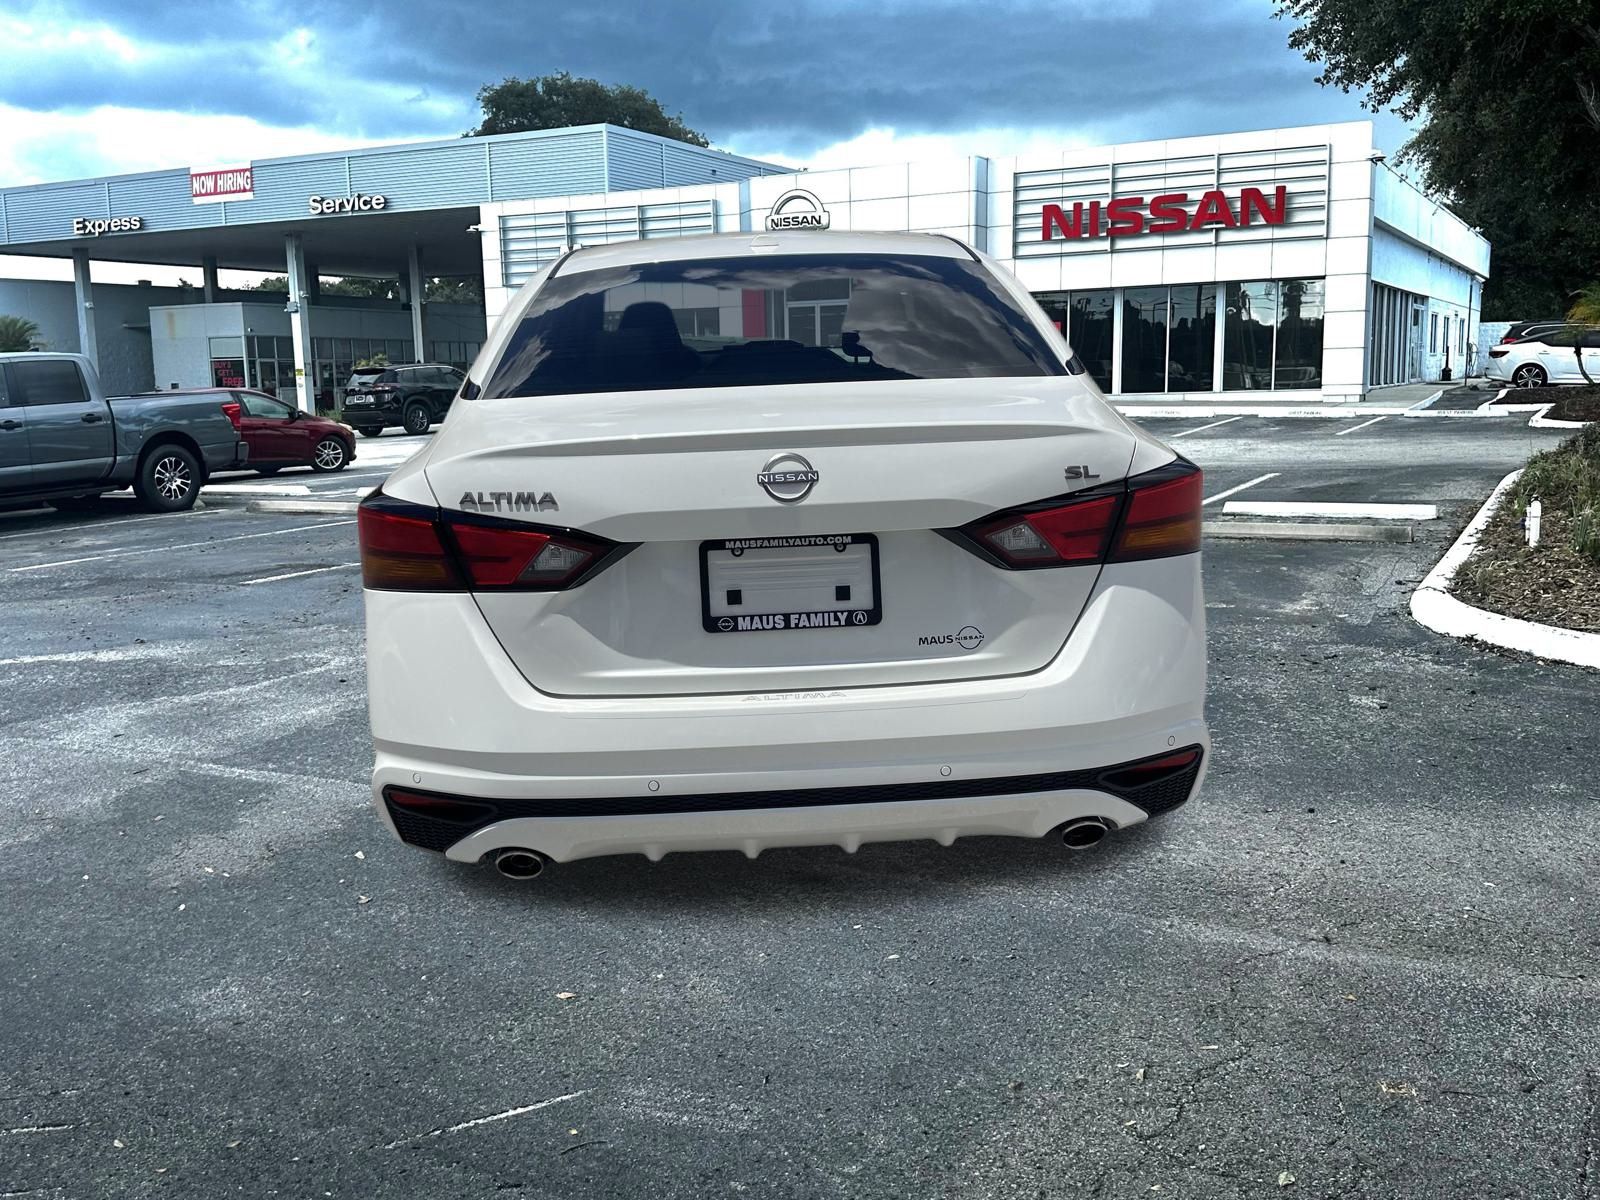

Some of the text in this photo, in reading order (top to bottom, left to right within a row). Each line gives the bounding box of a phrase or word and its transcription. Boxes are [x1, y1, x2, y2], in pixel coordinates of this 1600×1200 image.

[192, 171, 251, 195] NOW HIRING
[308, 193, 385, 215] Service
[1041, 185, 1287, 241] NISSAN
[72, 216, 141, 237] Express
[770, 215, 822, 228] NISSAN
[223, 377, 244, 386] FREE
[758, 472, 818, 483] NISSAN
[1064, 465, 1100, 479] SL
[459, 491, 558, 508] ALTIMA
[725, 535, 852, 550] MAUSFAMILYAUTO.COM
[737, 611, 849, 631] MAUS FAMILY
[918, 634, 954, 646] MAUS
[741, 691, 848, 702] ALTIMA
